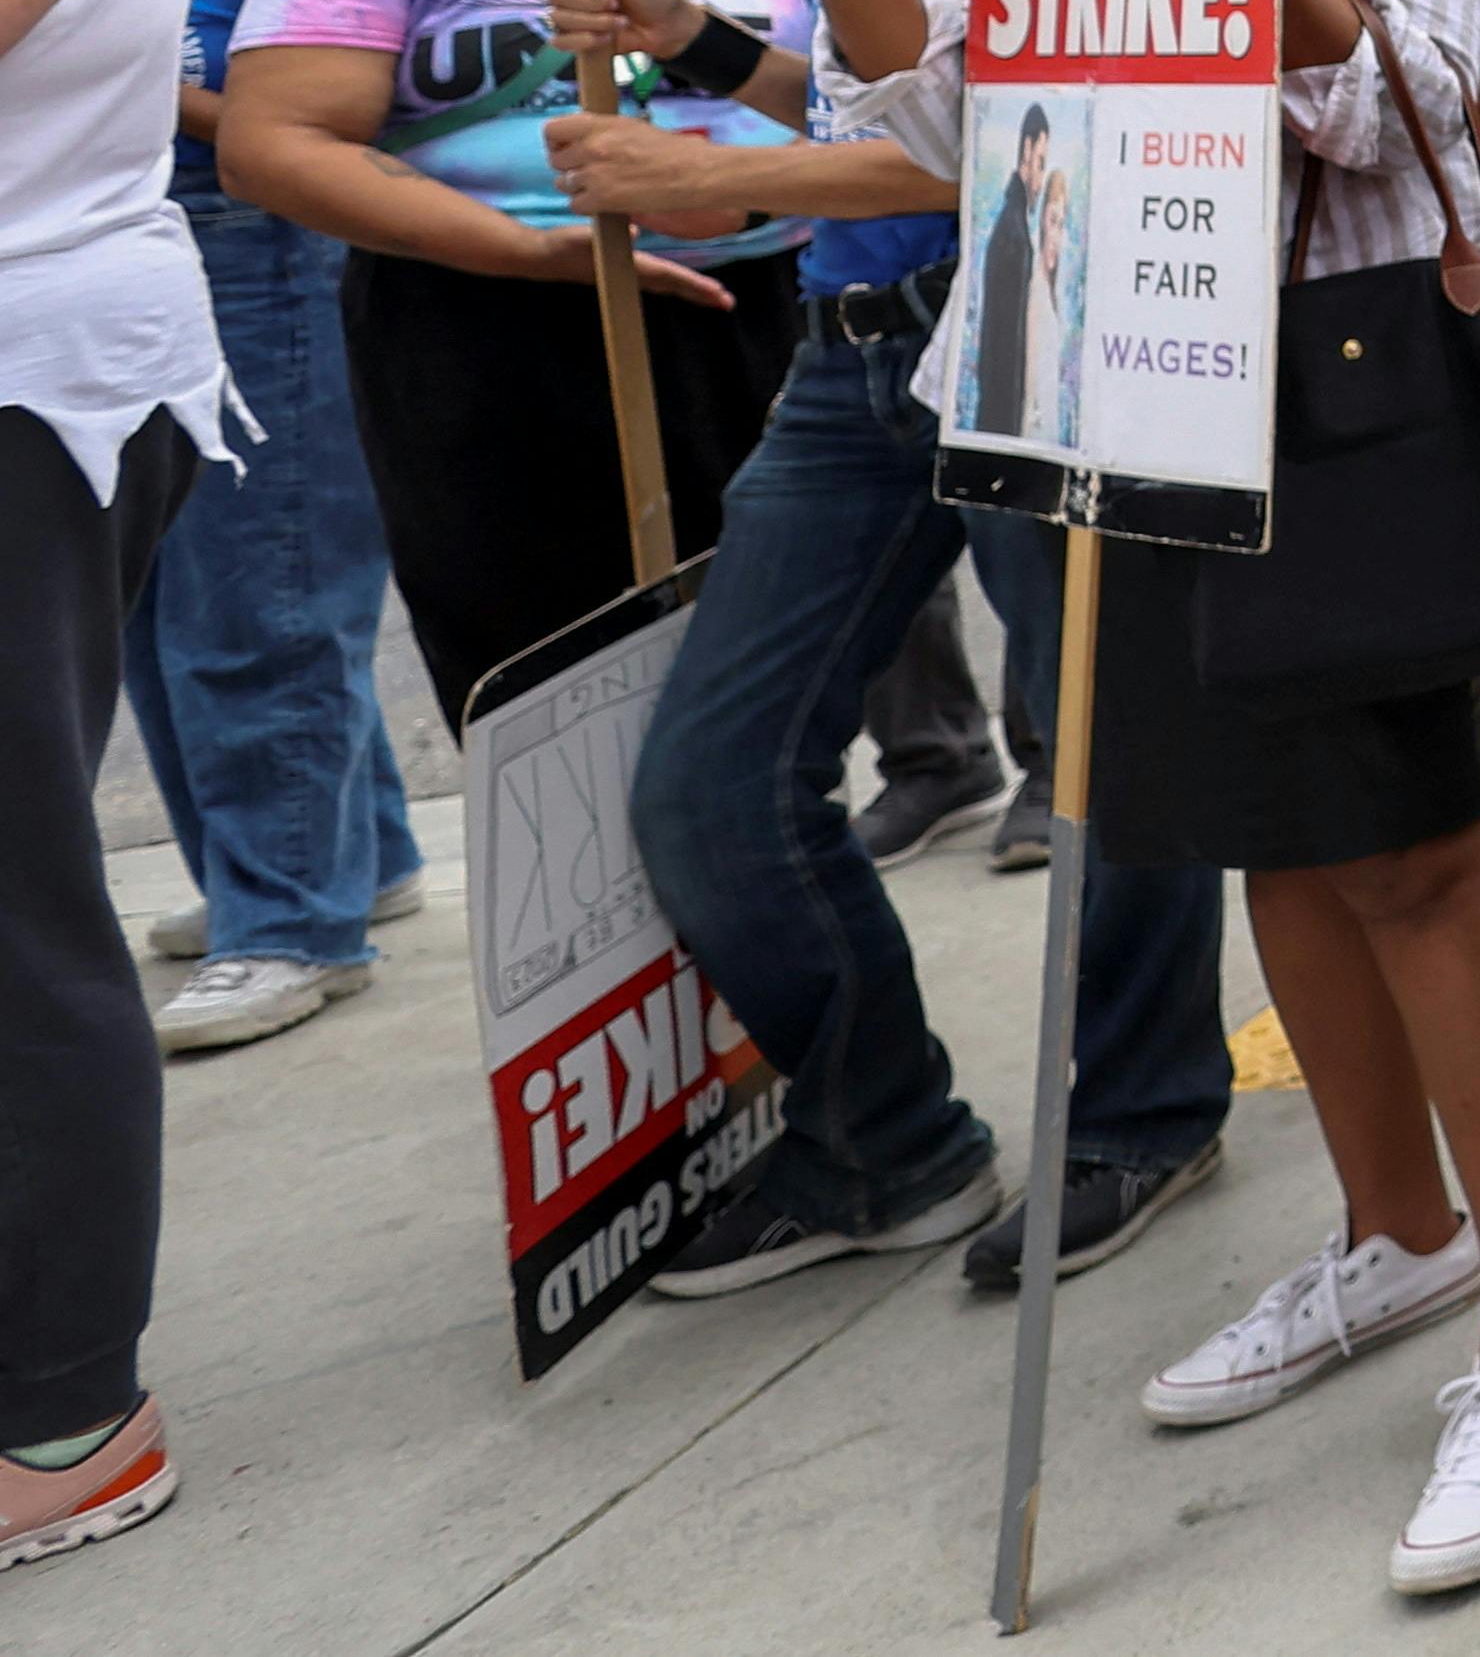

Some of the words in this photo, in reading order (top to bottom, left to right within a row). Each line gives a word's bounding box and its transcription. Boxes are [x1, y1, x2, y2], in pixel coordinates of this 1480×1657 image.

[1119, 130, 1127, 166] I
[1141, 130, 1247, 171] BURN
[1140, 195, 1216, 235] FOR
[1133, 261, 1218, 301] FAIR
[1101, 332, 1249, 382] WAGES!
[685, 1077, 727, 1139] ON
[535, 1178, 671, 1338] GUILD
